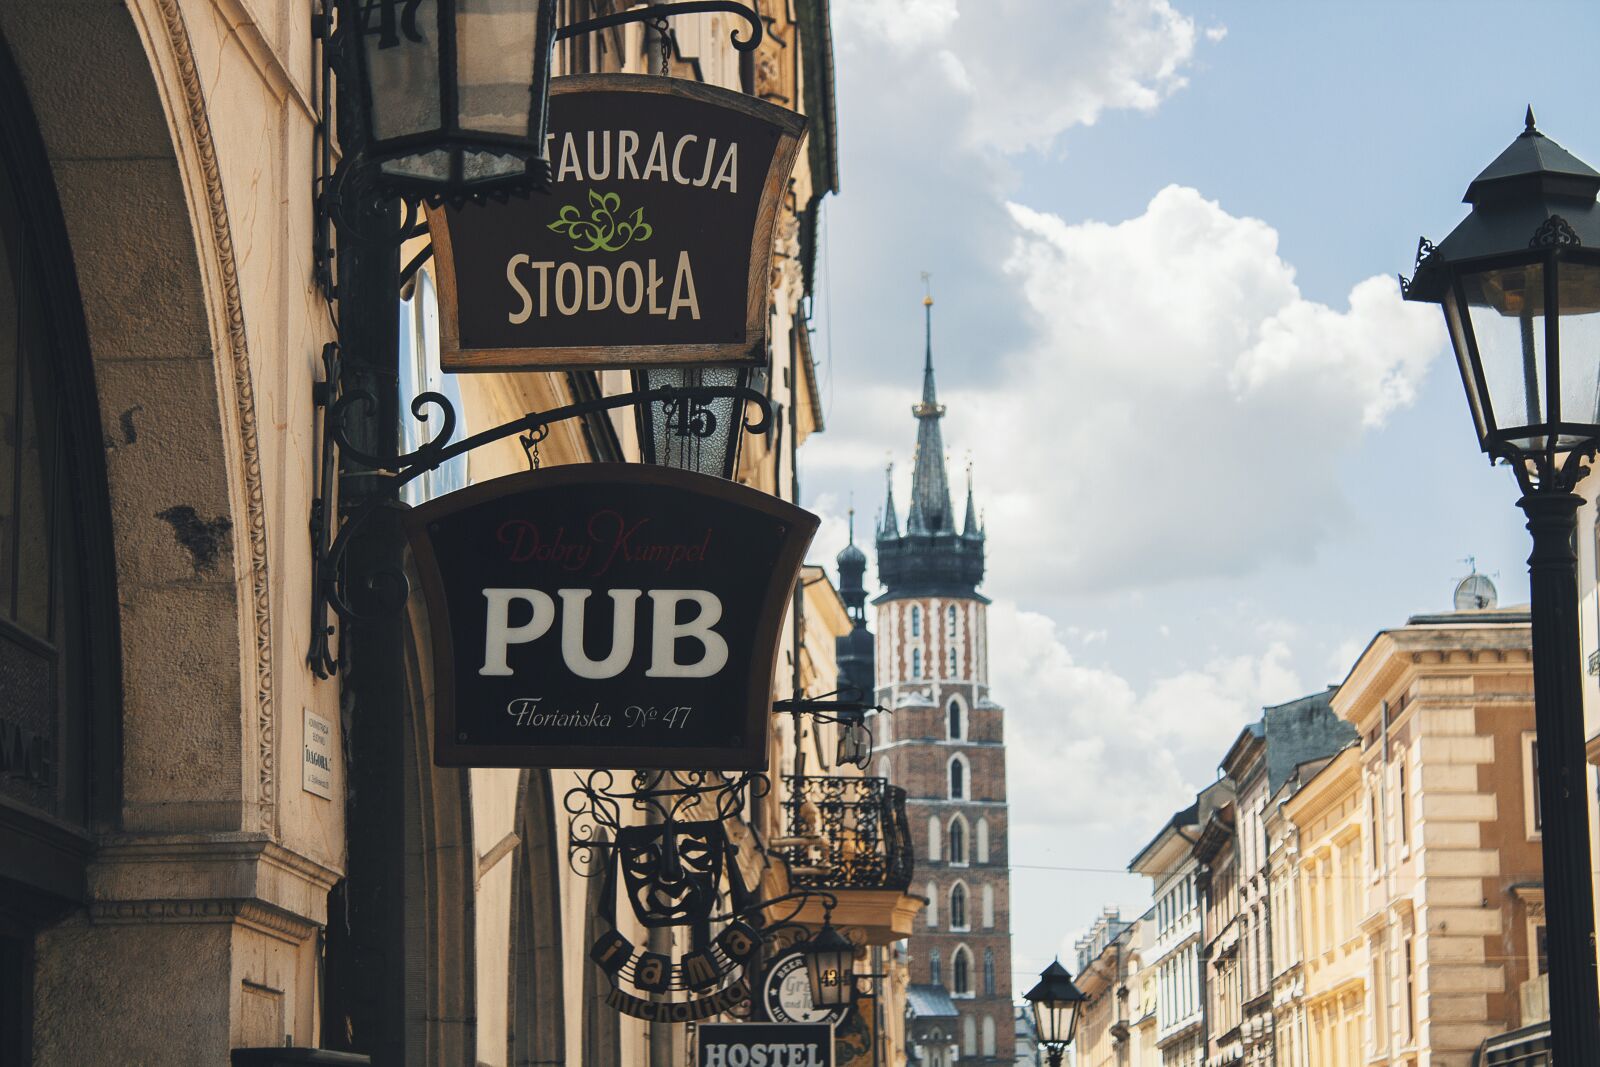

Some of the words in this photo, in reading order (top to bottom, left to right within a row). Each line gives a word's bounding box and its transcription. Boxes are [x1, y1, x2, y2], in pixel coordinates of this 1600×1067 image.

[506, 250, 701, 325] STODOŁA
[496, 519, 593, 571] Dobry
[587, 509, 712, 577] Kumpel
[478, 587, 729, 680] PUB
[507, 697, 612, 729] Floriańska
[662, 705, 692, 730] 47
[705, 1043, 825, 1067] HOSTEL
